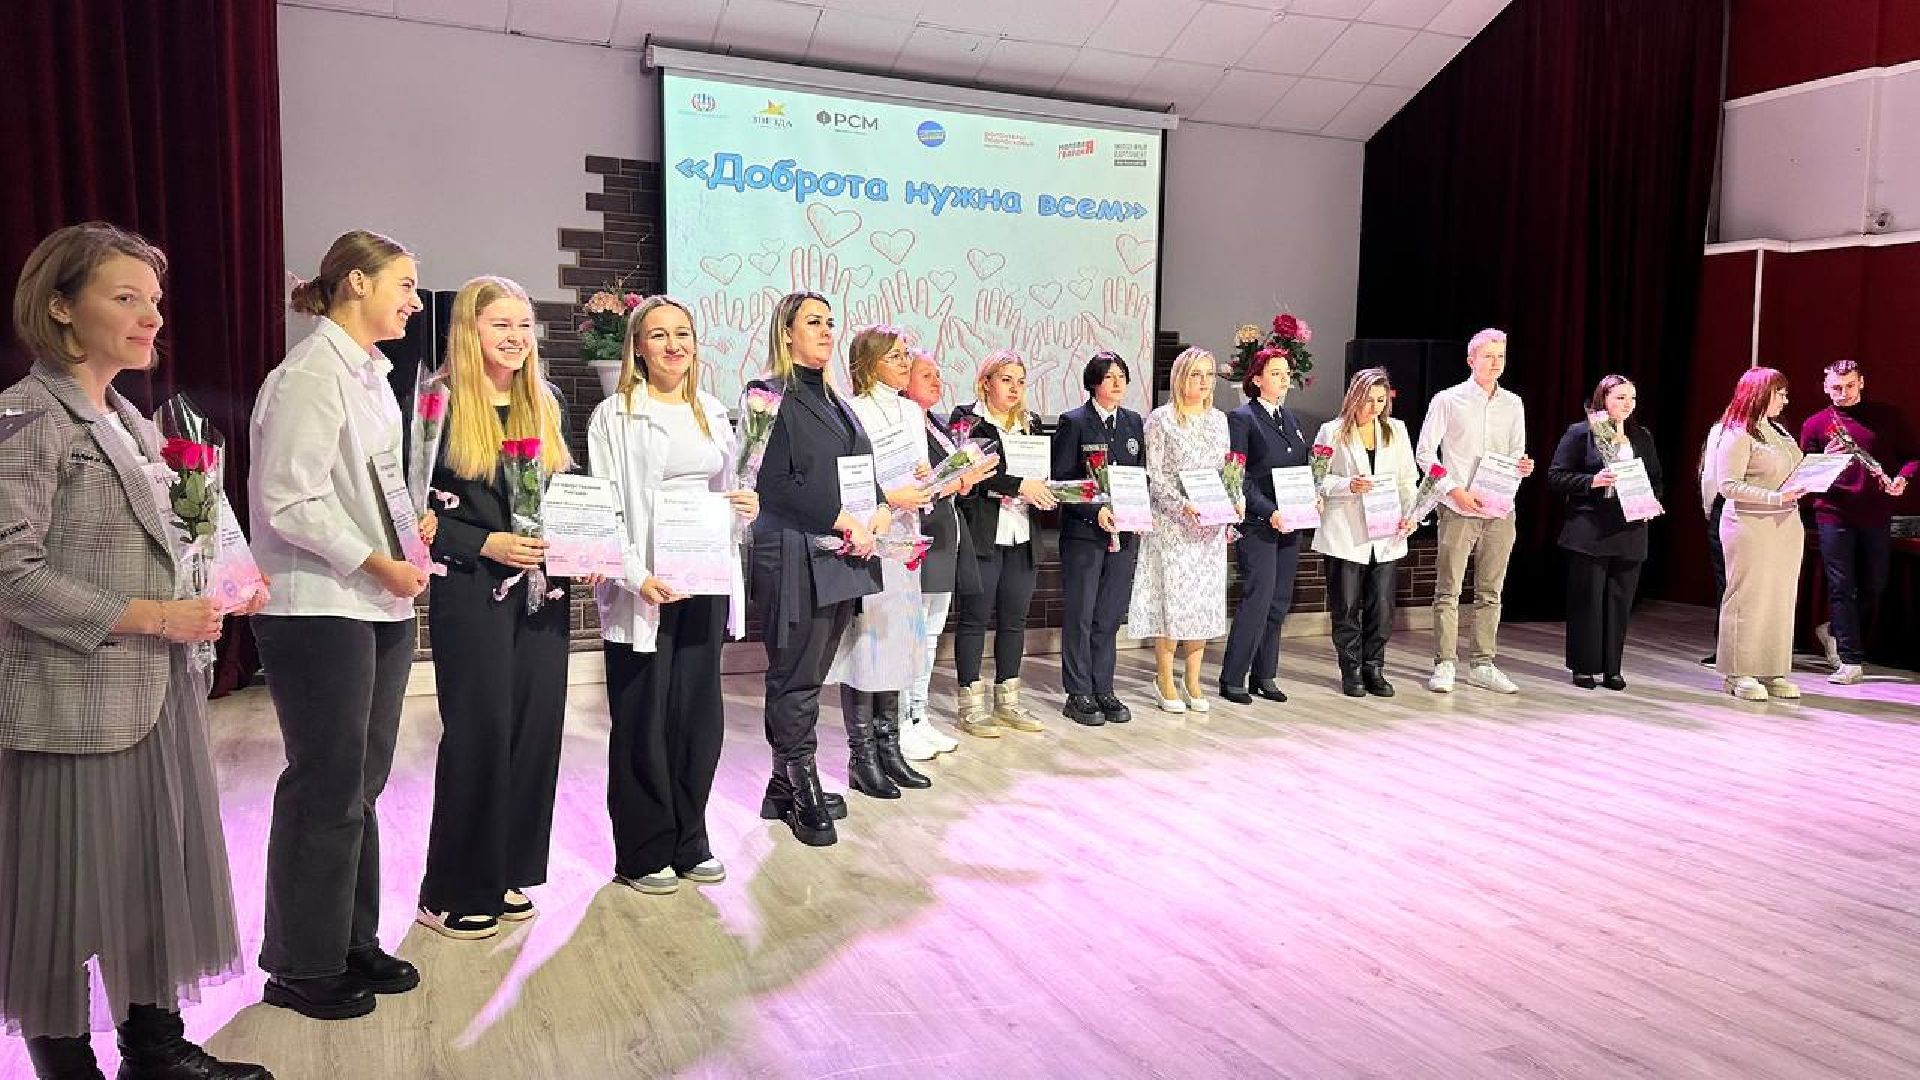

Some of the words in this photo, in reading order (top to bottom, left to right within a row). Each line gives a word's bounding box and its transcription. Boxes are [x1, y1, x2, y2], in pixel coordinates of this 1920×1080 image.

[834, 113, 878, 130] РСМ
[675, 153, 889, 203] «Доброта
[905, 179, 1022, 216] нужна
[1038, 194, 1148, 222] всем»
